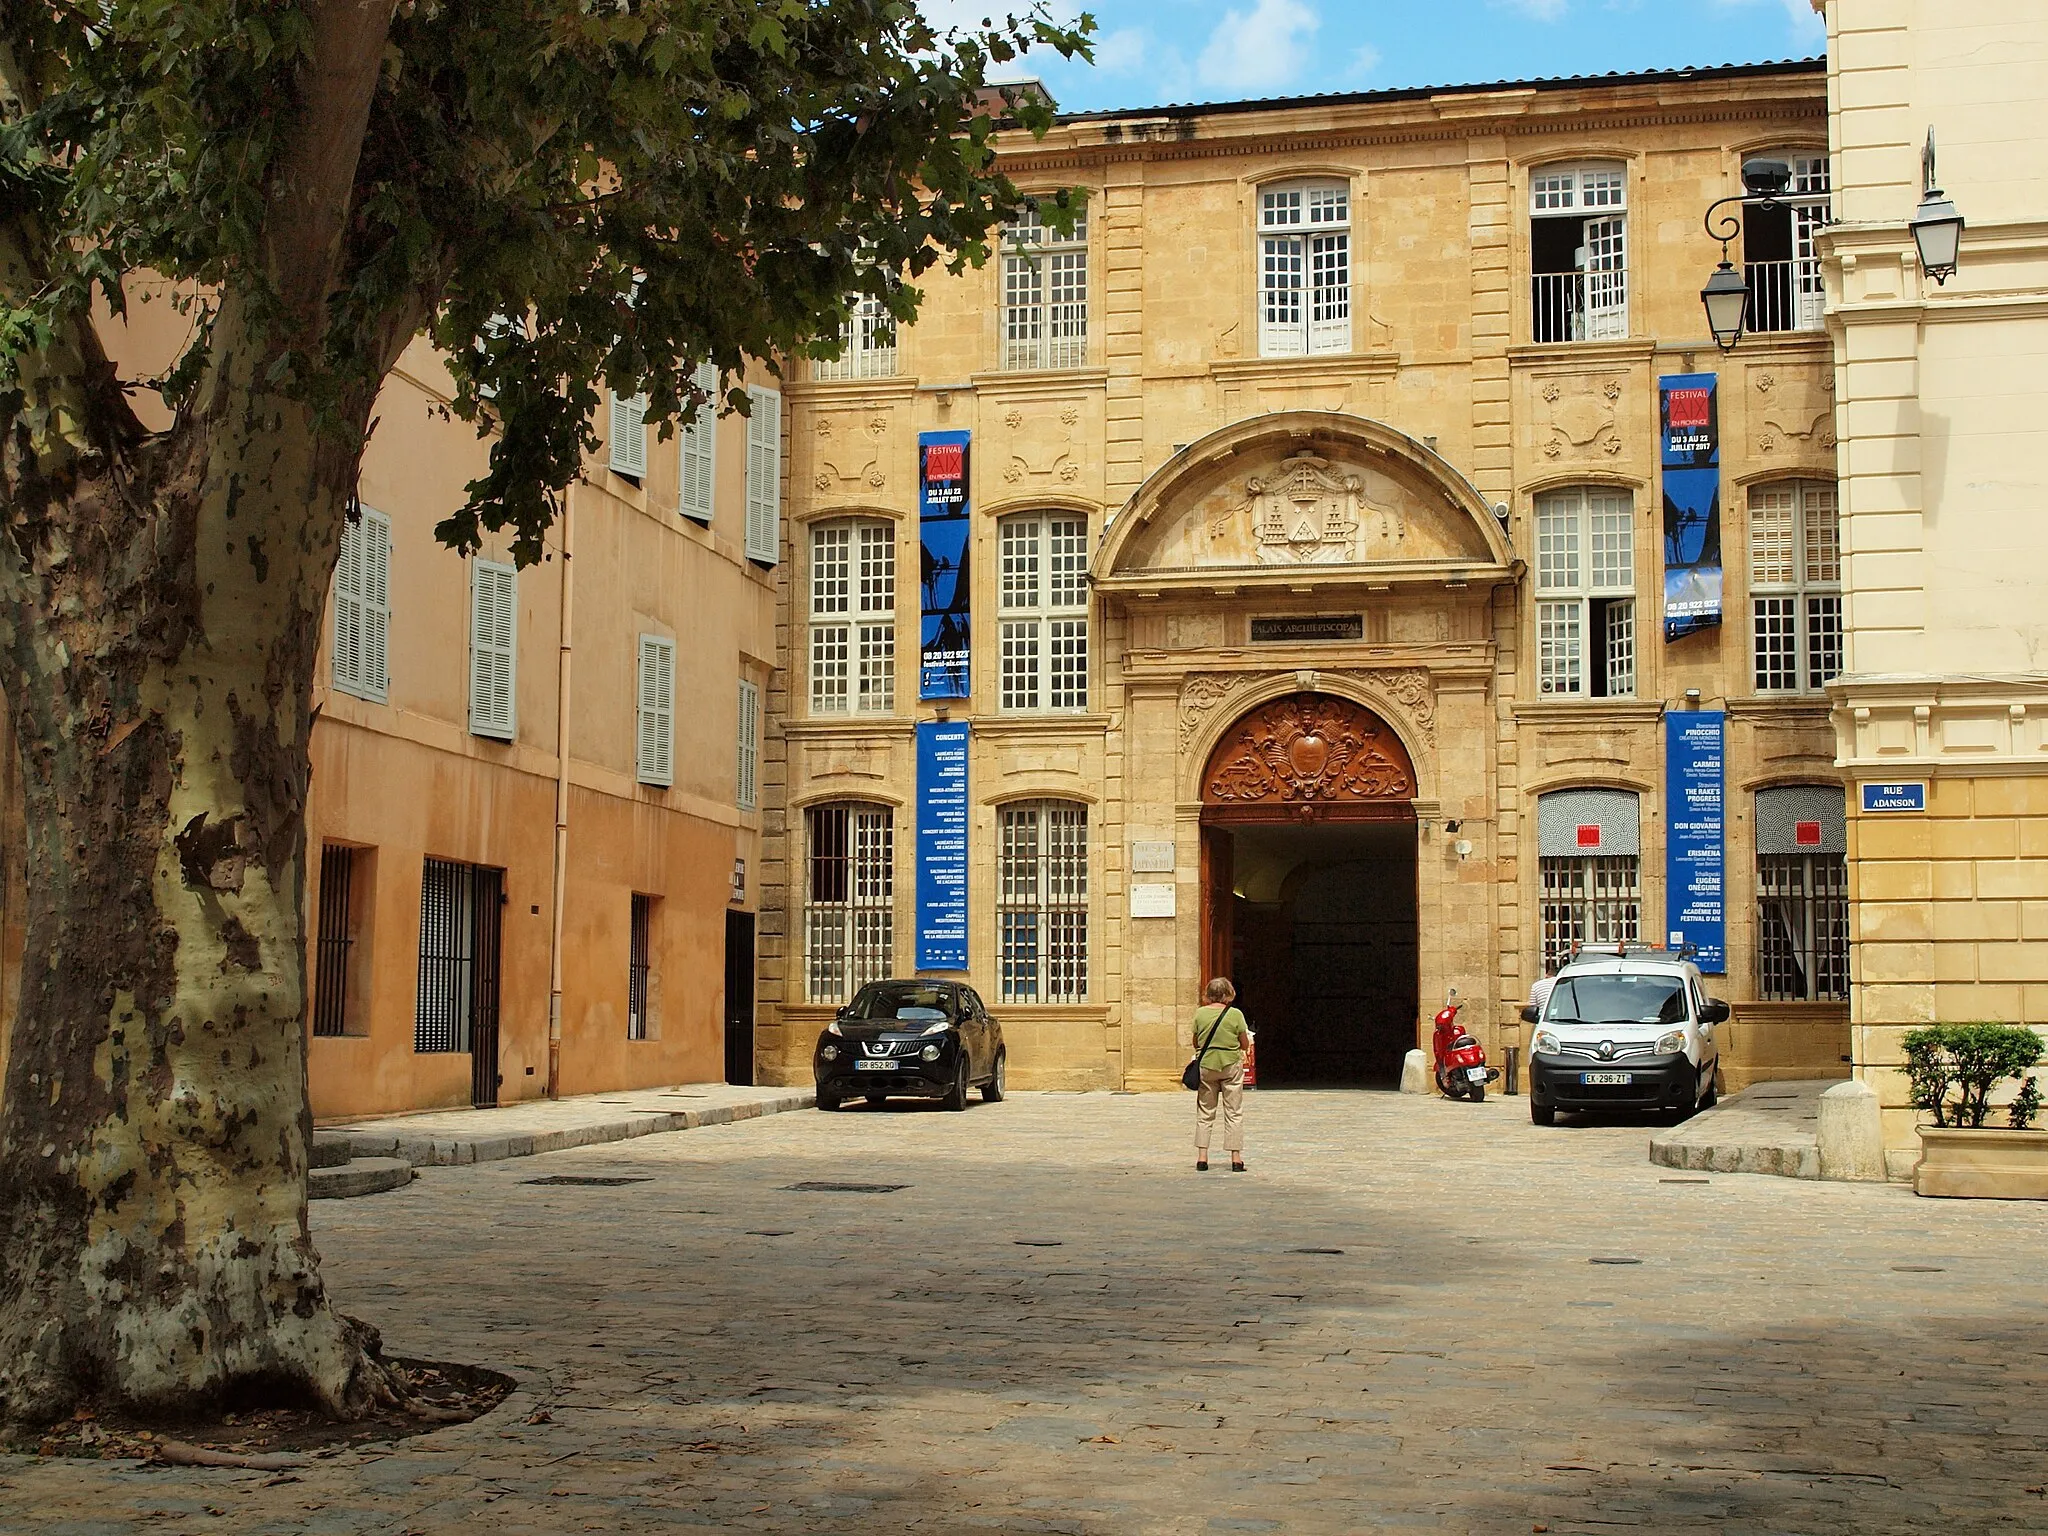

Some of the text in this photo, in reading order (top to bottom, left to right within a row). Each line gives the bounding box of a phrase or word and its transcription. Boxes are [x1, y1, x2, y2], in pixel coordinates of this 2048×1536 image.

[1670, 391, 1706, 399] FESTIVAL
[1667, 608, 1718, 617] festival-aix.com
[1252, 625, 1282, 633] PALAIS
[933, 652, 942, 660] 20
[942, 651, 955, 659] 922
[1873, 799, 1915, 807] ADANSON
[1586, 1074, 1626, 1083] EK-296-ZT
